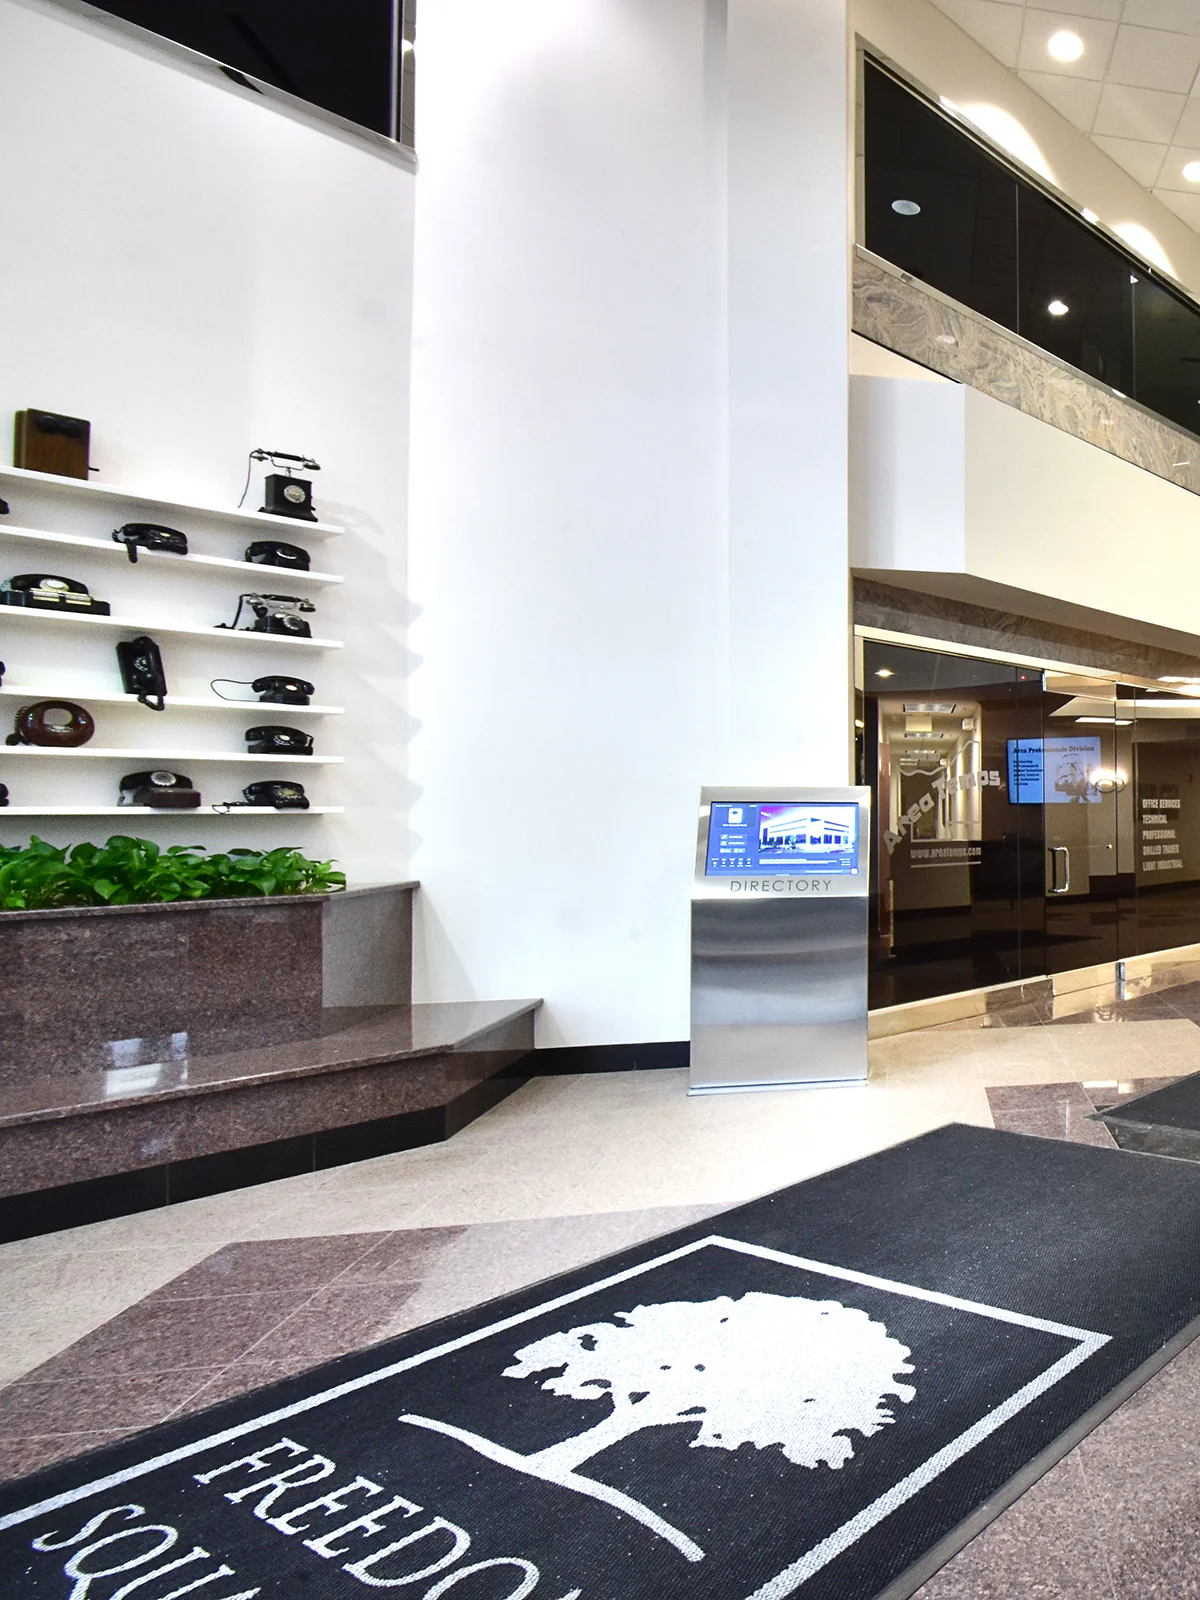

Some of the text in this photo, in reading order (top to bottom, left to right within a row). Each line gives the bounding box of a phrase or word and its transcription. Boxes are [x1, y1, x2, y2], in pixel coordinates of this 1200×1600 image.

[1142, 799, 1181, 808] OFFICE SERVICES
[883, 770, 1000, 855] Area Temps
[1142, 814, 1168, 824] TECHNICAL
[1142, 829, 1176, 840] PROFESSIONAL
[910, 847, 982, 859] www.areatemps.com
[1143, 844, 1180, 855] SKILLED TRADES
[1142, 859, 1183, 871] LIGHT INDUSTRIAL
[730, 879, 832, 892] DIRECTORY
[193, 1437, 583, 1600] FREEDO
